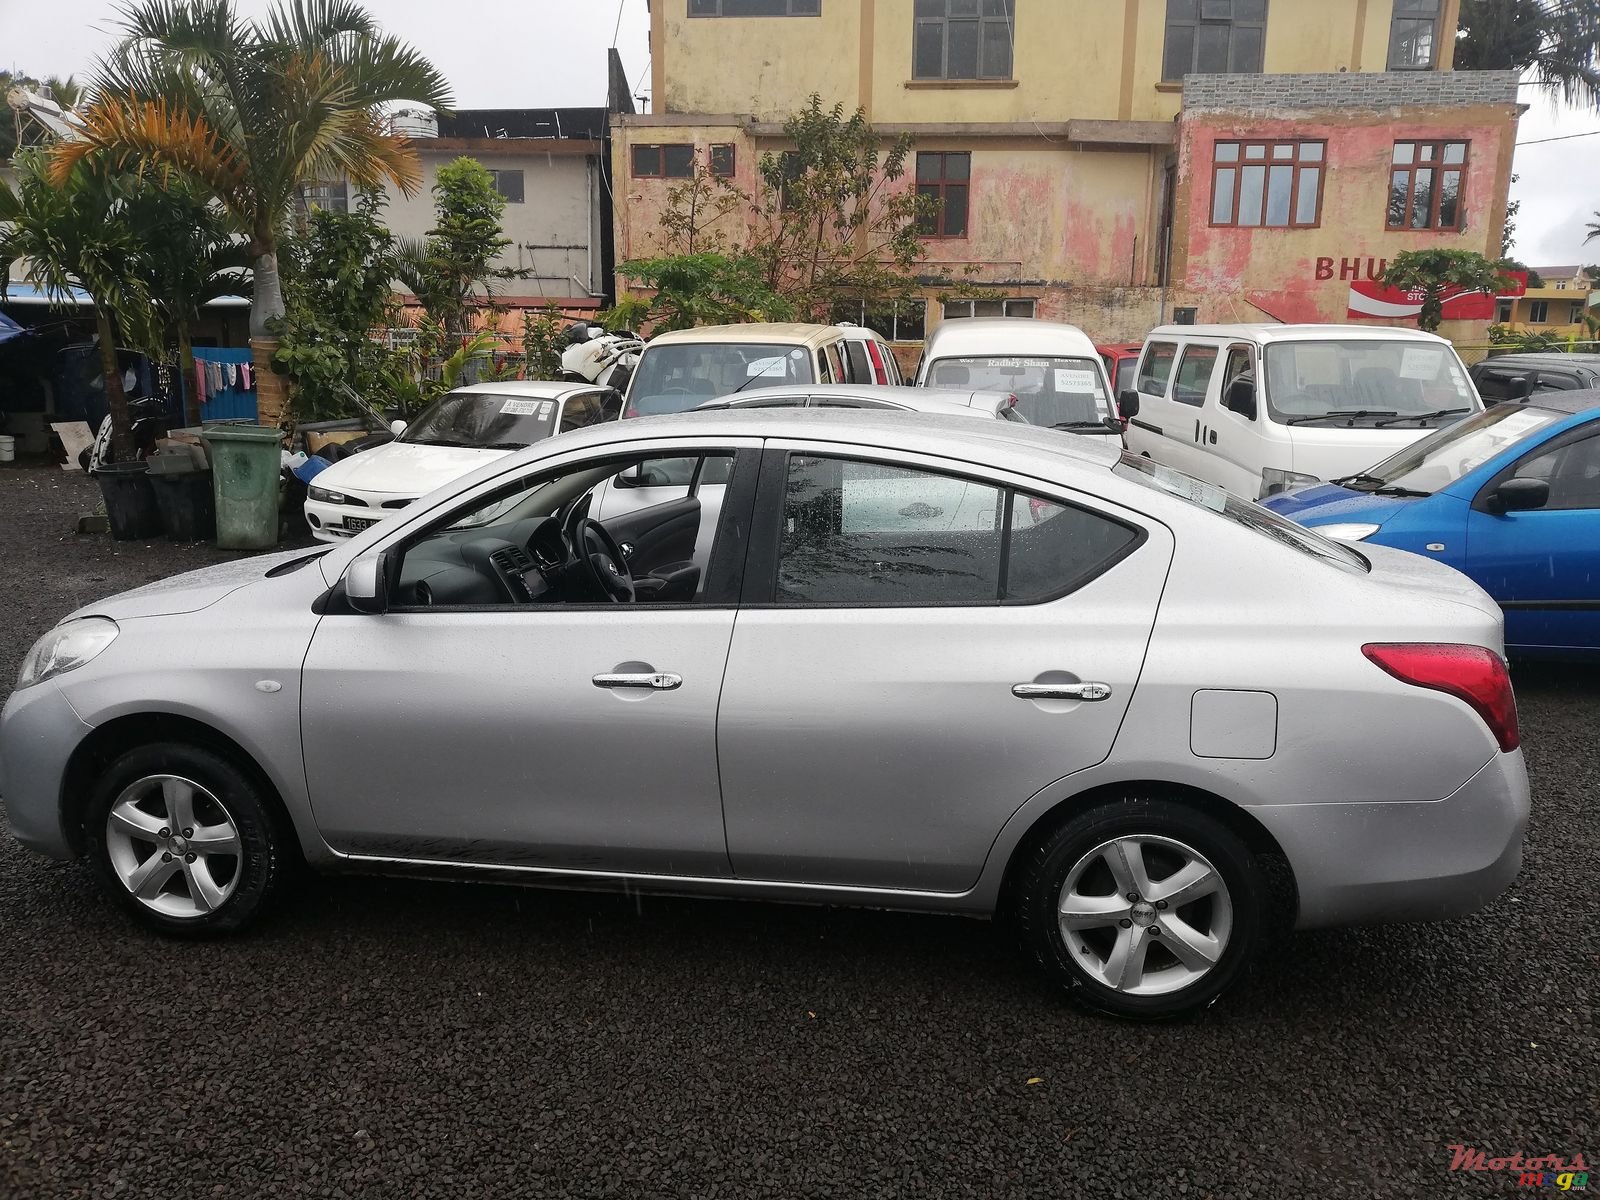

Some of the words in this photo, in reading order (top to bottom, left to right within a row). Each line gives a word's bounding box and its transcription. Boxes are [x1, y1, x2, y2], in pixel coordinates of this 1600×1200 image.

[1315, 257, 1399, 280] BHU
[987, 359, 1021, 368] Radhey
[1024, 359, 1050, 367] Sham
[347, 518, 367, 530] 1633
